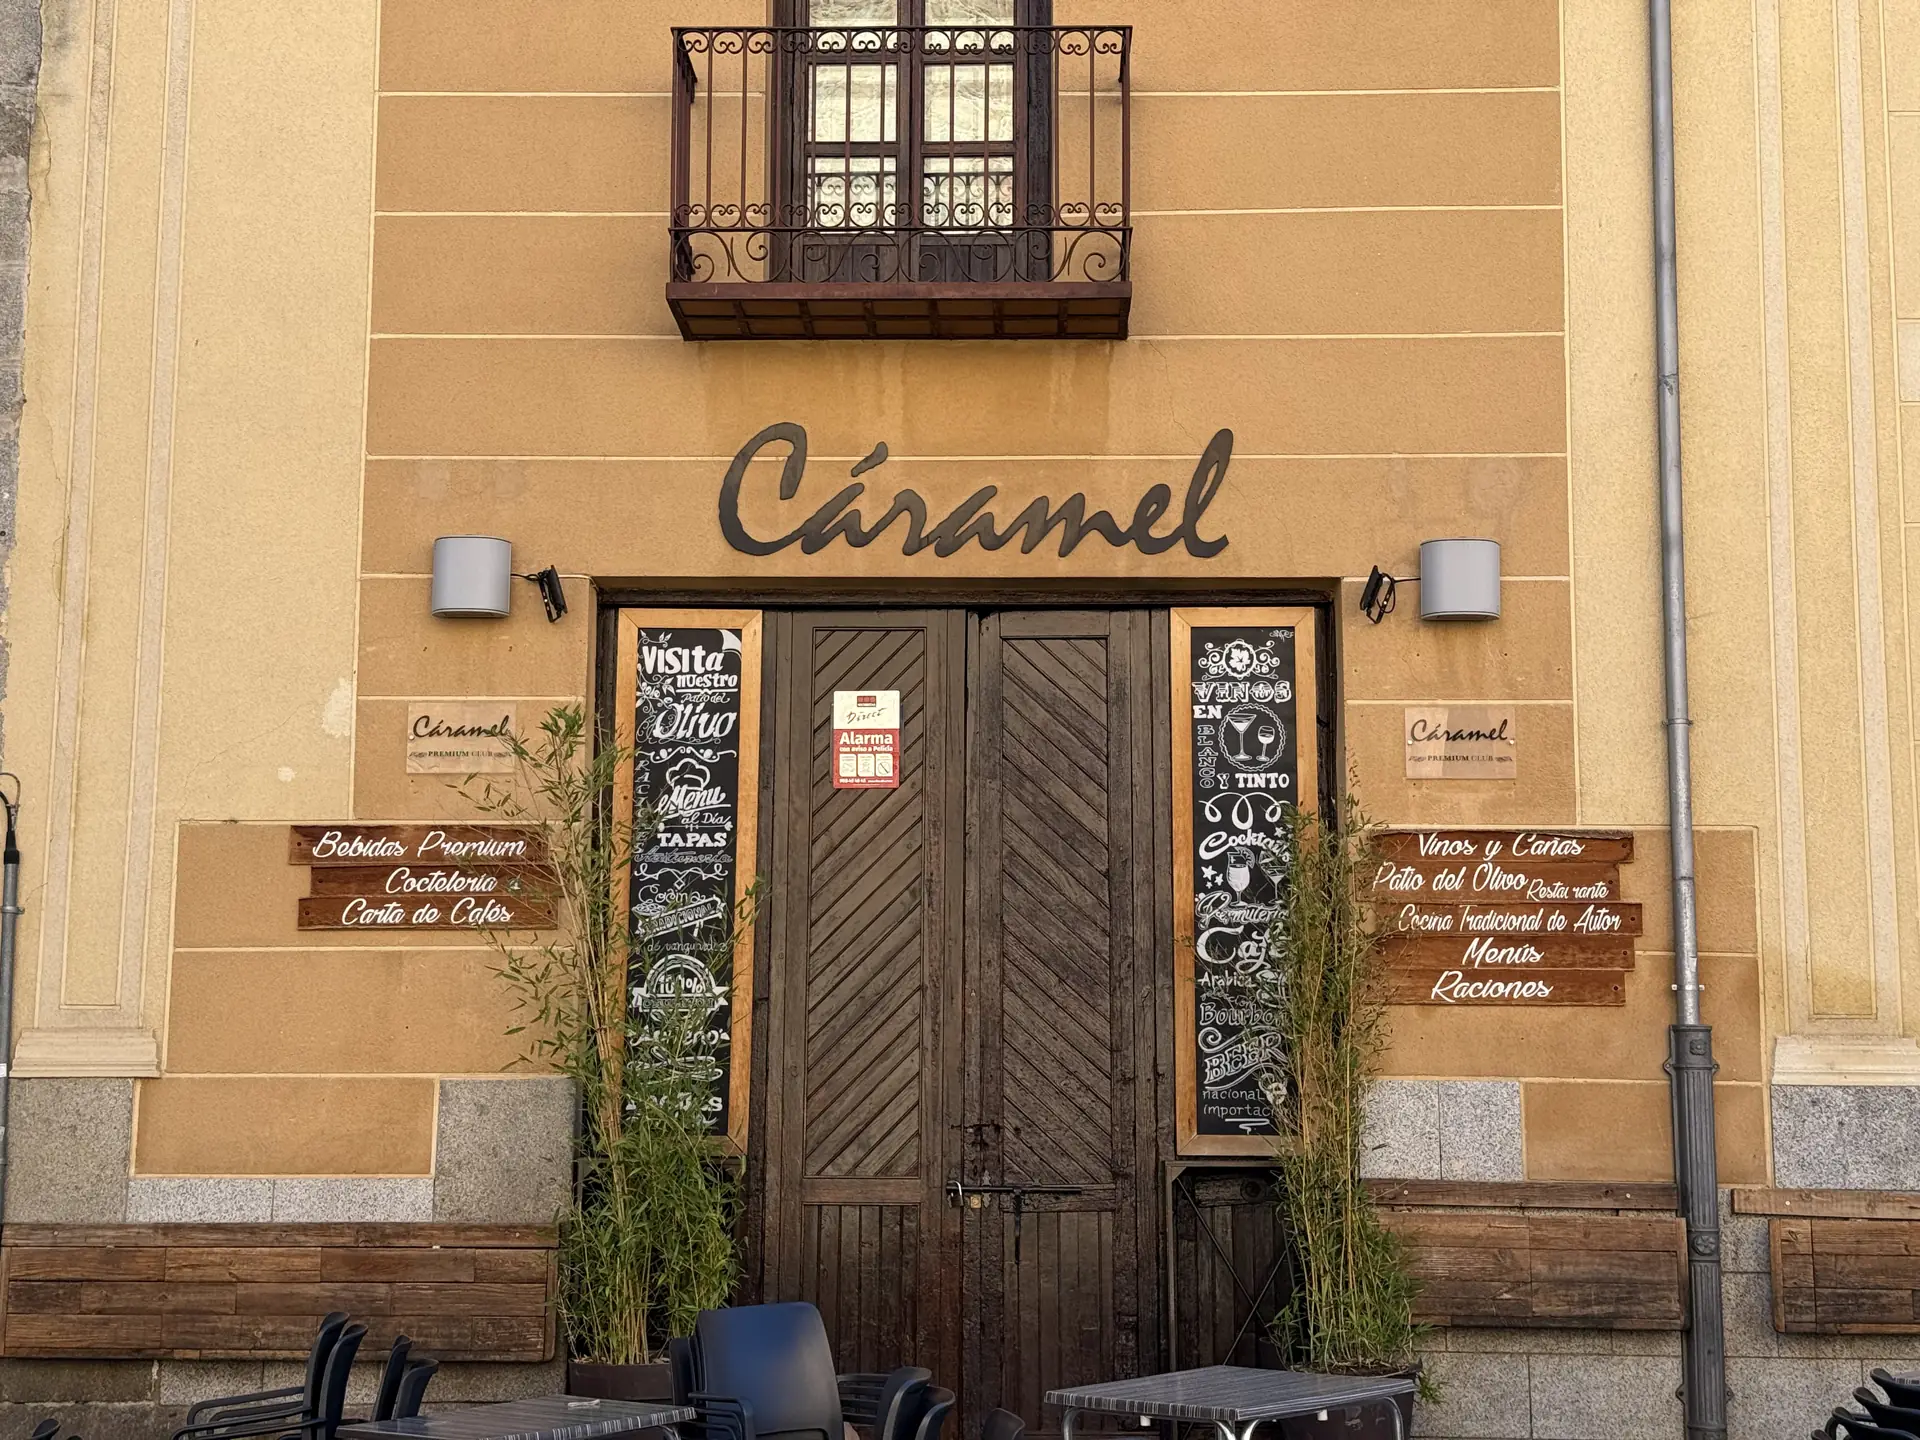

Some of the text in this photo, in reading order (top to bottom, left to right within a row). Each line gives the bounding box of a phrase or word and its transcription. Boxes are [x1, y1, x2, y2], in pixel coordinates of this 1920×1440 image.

[718, 422, 1233, 557] Cáramel
[711, 692, 731, 703] del
[1192, 680, 1292, 703] VINOS
[653, 702, 738, 740] Olivo
[1192, 705, 1223, 719] EN
[413, 715, 509, 738] Cáramel
[839, 731, 893, 745] Alarma
[1410, 719, 1508, 741] Cáramel
[1197, 725, 1219, 788] BLANCO
[1216, 773, 1290, 789] Y TINTO
[681, 812, 699, 824] al
[312, 831, 526, 858] Bebidas Premium
[657, 832, 727, 847] TAPAS
[1199, 829, 1292, 860] Cocktails
[1418, 832, 1585, 861] Vinos y Cañas
[385, 867, 498, 894] Coctelería
[1372, 861, 1529, 892] Patio del Olivo
[341, 897, 514, 926] Carta de Cafés
[1398, 903, 1622, 933] Cocina Tradicional de Autor
[1462, 937, 1545, 968] Menús
[1431, 970, 1554, 1003] Raciones
[1203, 1032, 1288, 1084] BEER
[1203, 1089, 1266, 1101] nacional
